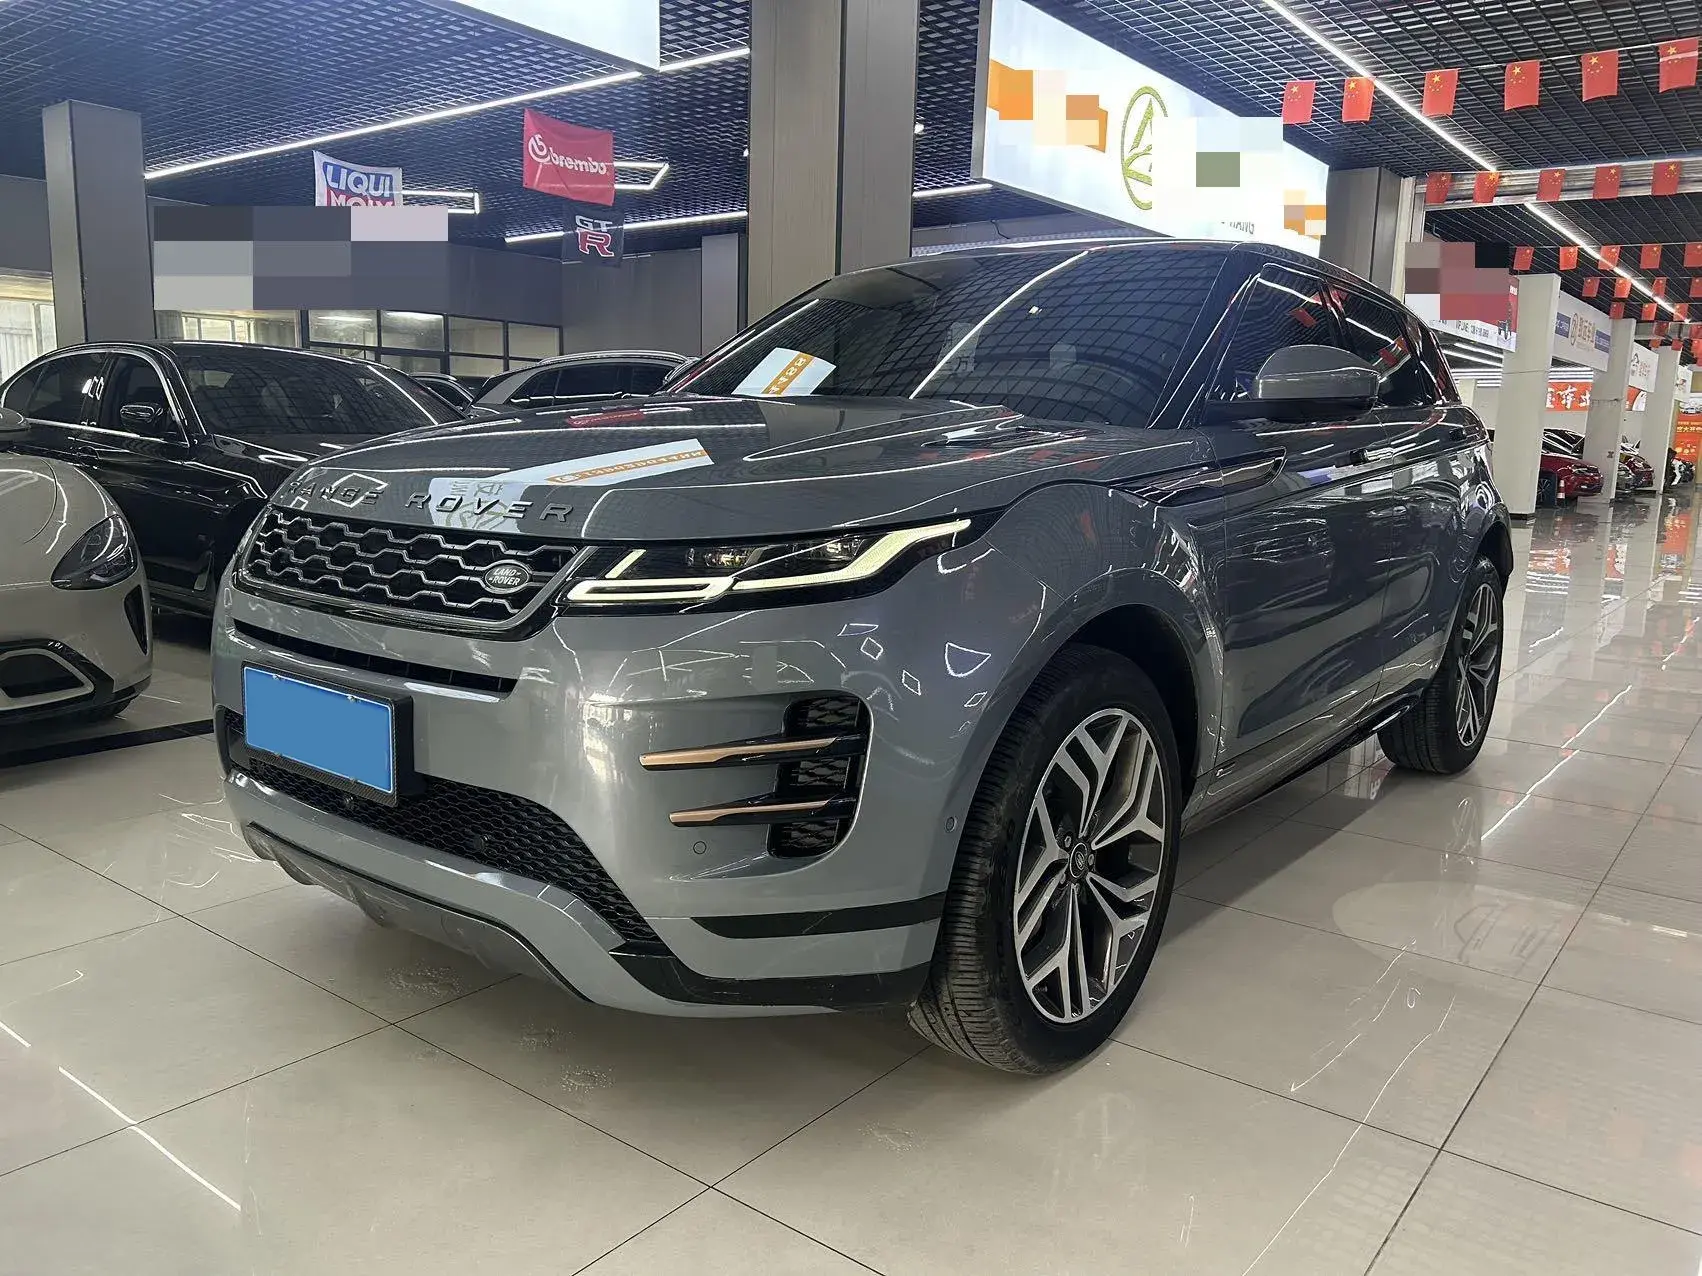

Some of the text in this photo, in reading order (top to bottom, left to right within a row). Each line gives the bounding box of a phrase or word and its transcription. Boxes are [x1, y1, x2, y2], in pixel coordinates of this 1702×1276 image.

[549, 147, 607, 175] brembo
[326, 165, 390, 198] LIQUI
[575, 215, 613, 232] GT
[576, 228, 614, 257] R
[288, 480, 573, 522] RANGE ROVER
